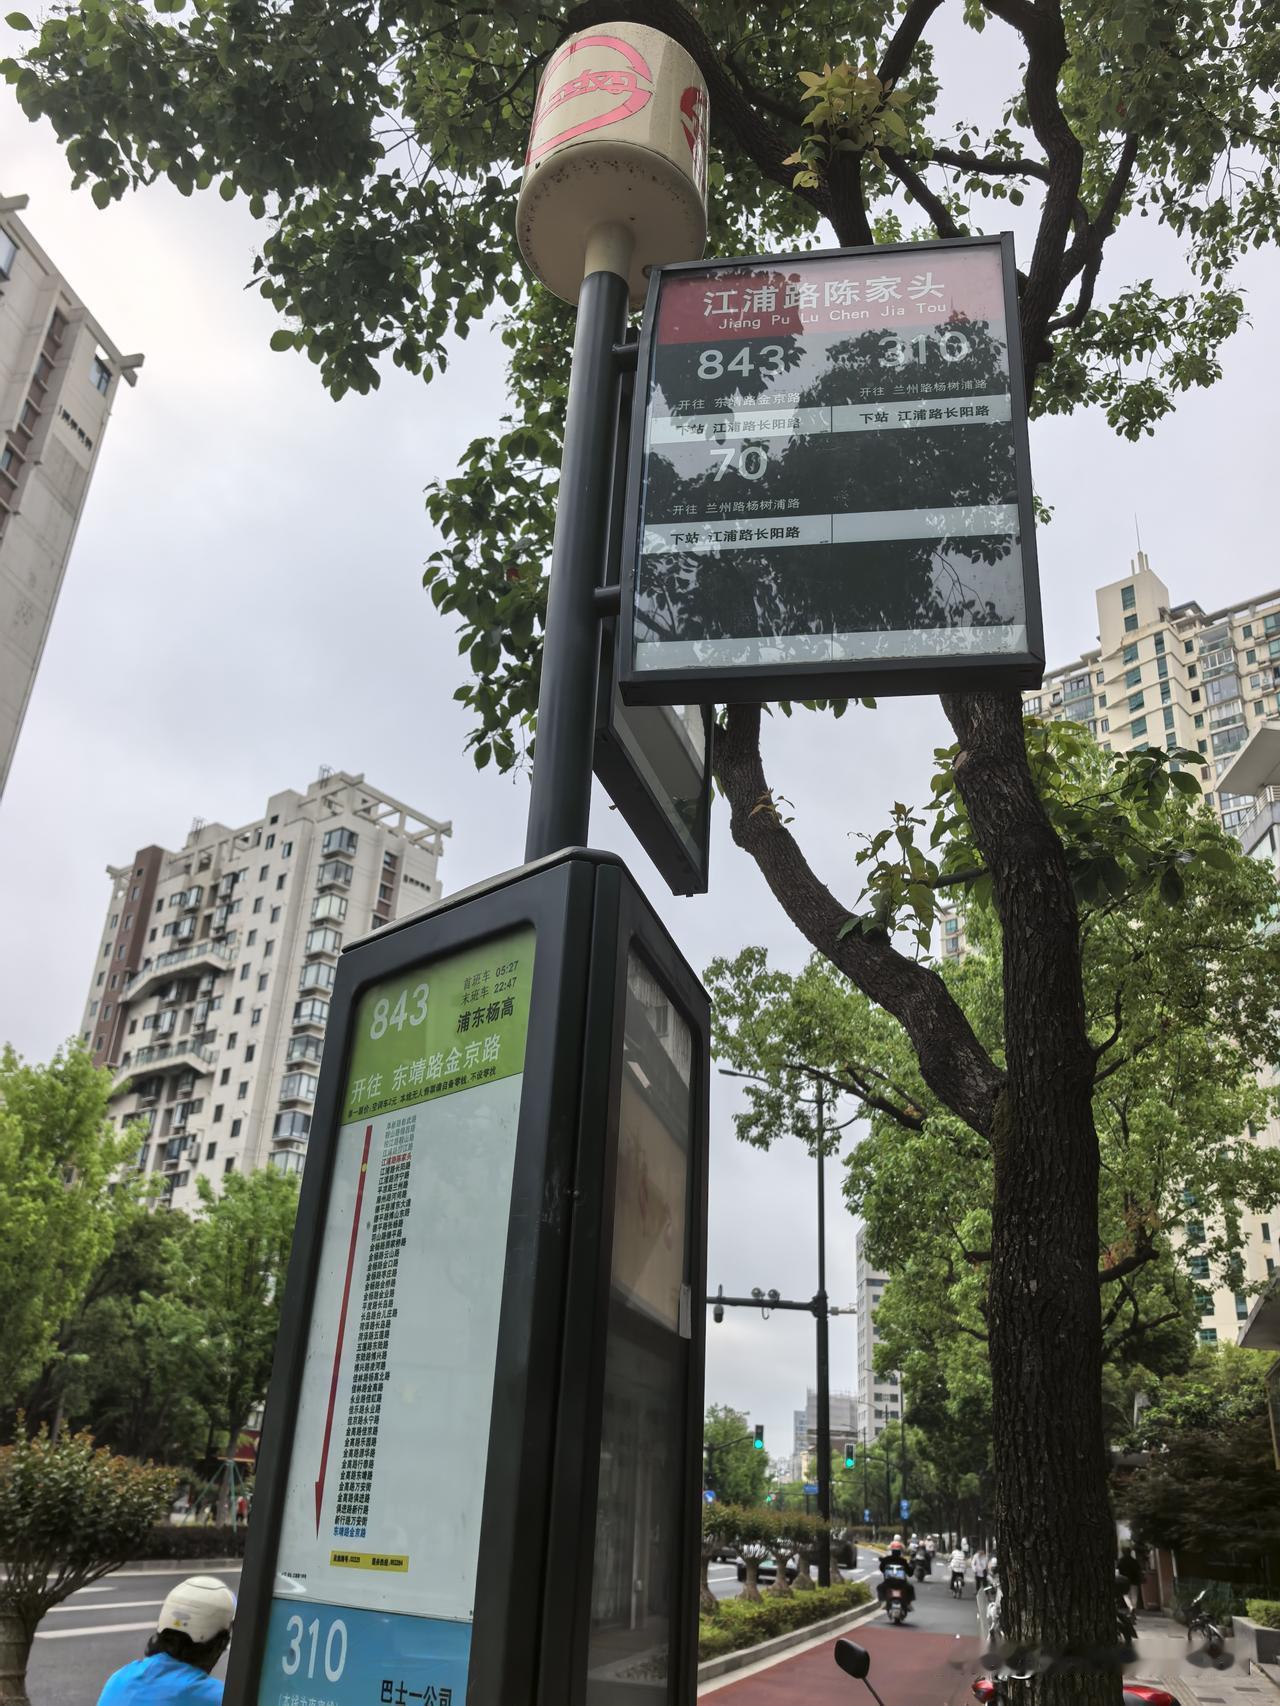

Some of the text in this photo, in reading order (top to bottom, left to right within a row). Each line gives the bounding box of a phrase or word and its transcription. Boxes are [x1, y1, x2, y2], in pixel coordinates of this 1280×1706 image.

[703, 272, 945, 317] 江浦路陈家头
[719, 303, 946, 330] Jiang Pu Lu Chen Jia Tou
[698, 345, 785, 380] 843
[878, 331, 969, 367] 310
[860, 380, 988, 397] 开往 兰州路杨树浦路
[679, 399, 705, 410] 开往
[859, 405, 990, 424] 下站 江浦路长阳路
[677, 418, 800, 436] 下站 江浦路长阳路
[710, 446, 768, 482] 70
[672, 498, 800, 515] 开往 兰州路杨树浦路
[671, 526, 800, 545] 下站 江浦路长阳路
[464, 960, 519, 990] 首班车 05:27
[462, 977, 517, 1005] 末班车 22:47
[370, 983, 430, 1040] 843
[456, 996, 516, 1033] 浦东杨高
[351, 1034, 501, 1105] 开往 东靖路金京路
[380, 1161, 411, 1176] 江浦路长阳路
[381, 1152, 412, 1167] 江浦路陈家头
[367, 1259, 399, 1272] 金杨路金口路
[334, 1525, 366, 1538] 东靖路金京路
[282, 1615, 348, 1682] 310
[380, 1679, 452, 1706] 巴士一公司
